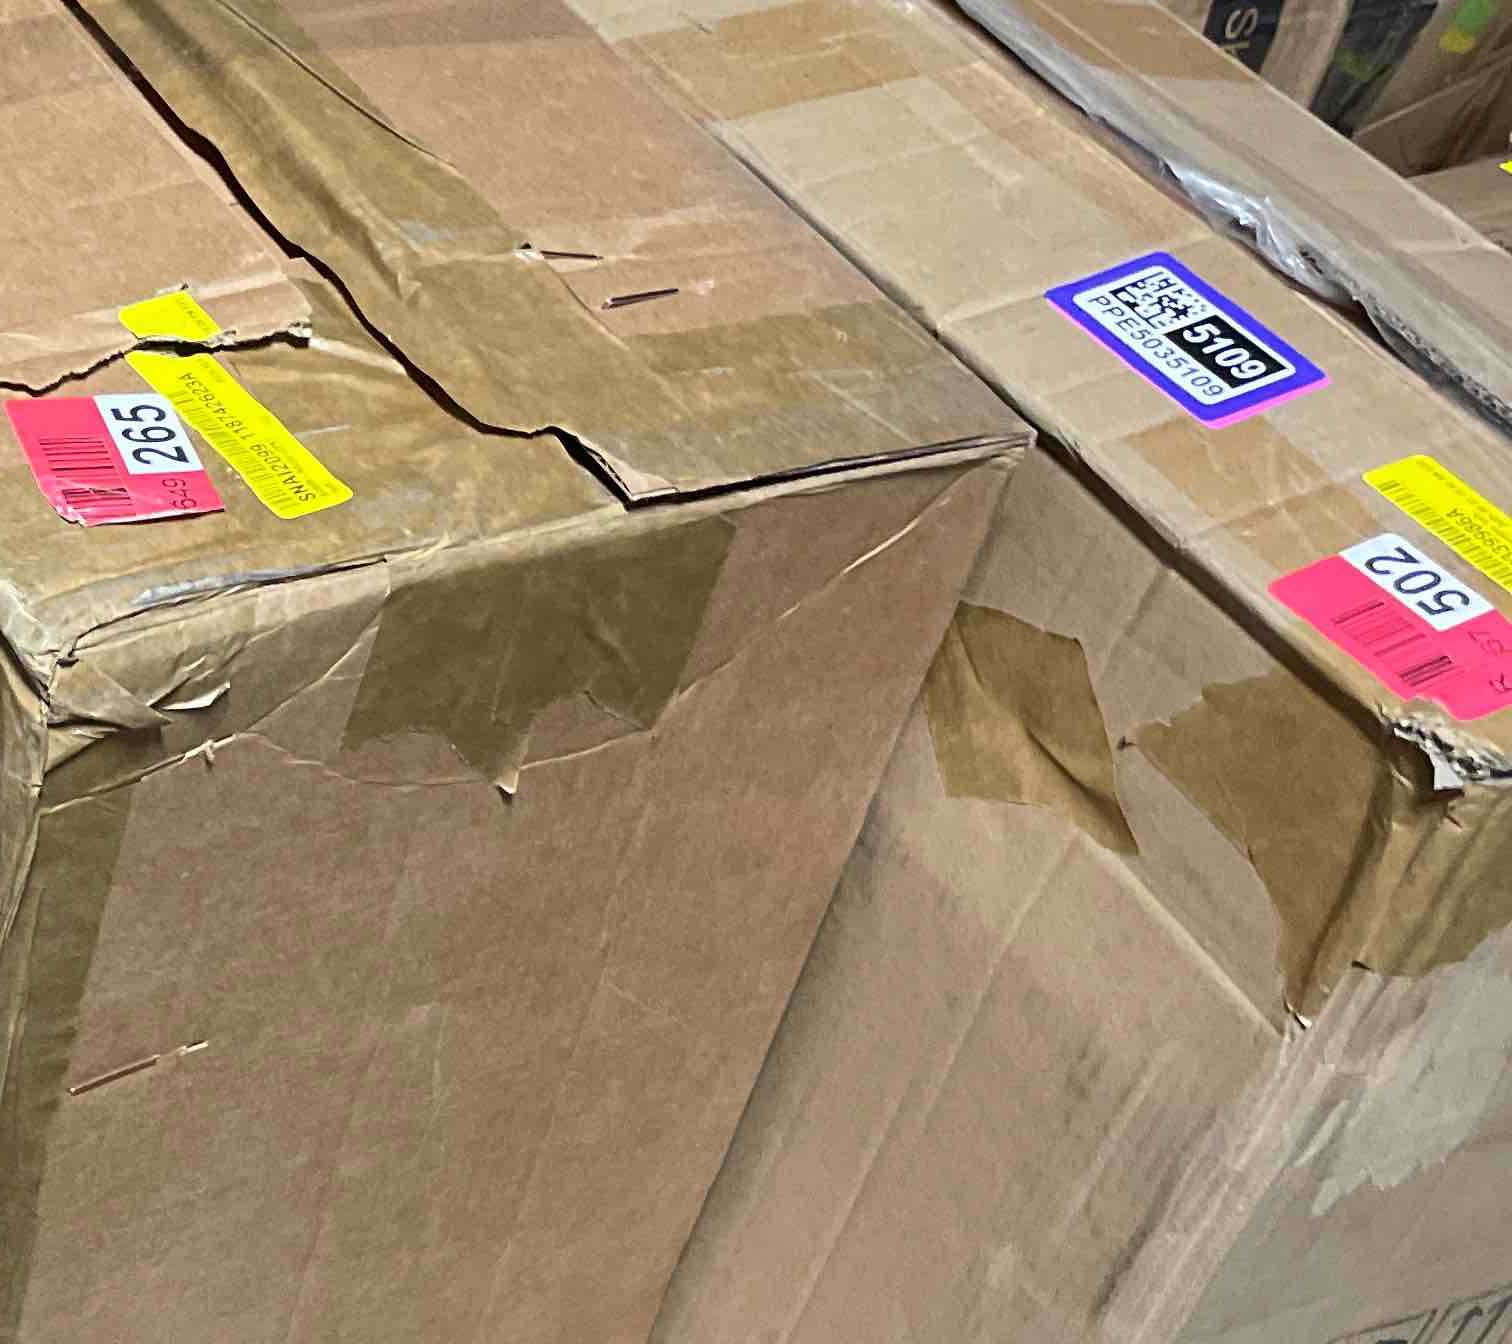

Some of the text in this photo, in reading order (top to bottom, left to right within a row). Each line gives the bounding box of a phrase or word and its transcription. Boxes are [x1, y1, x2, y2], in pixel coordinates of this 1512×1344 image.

[1088, 295, 1225, 397] PPE5035109
[1182, 322, 1268, 380] 5109
[111, 404, 190, 465] 265
[1364, 546, 1471, 616] 502
